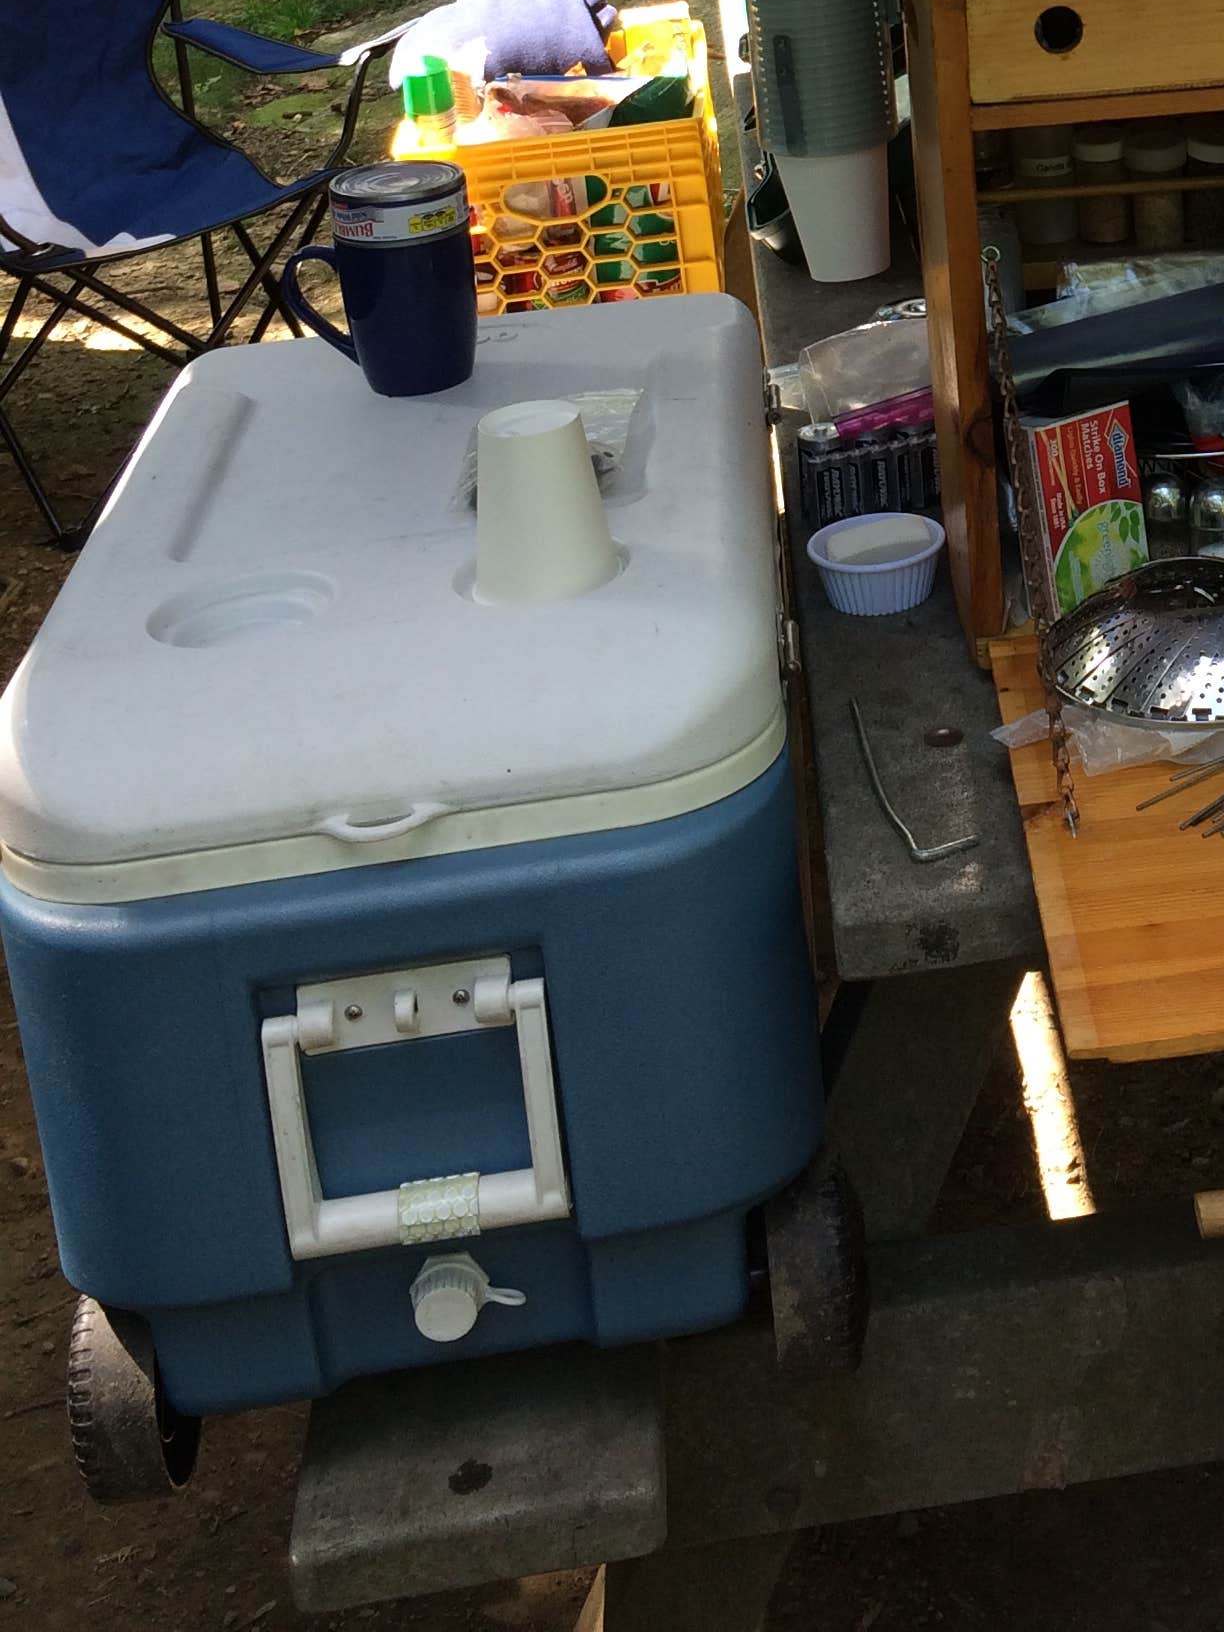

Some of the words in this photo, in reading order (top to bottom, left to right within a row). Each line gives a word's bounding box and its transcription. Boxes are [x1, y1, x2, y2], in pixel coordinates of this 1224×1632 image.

[1081, 422, 1093, 470] Matches
[1089, 420, 1102, 452] Strike
[1094, 453, 1104, 471] On
[1112, 431, 1131, 488] diamond
[1097, 471, 1107, 495] Box
